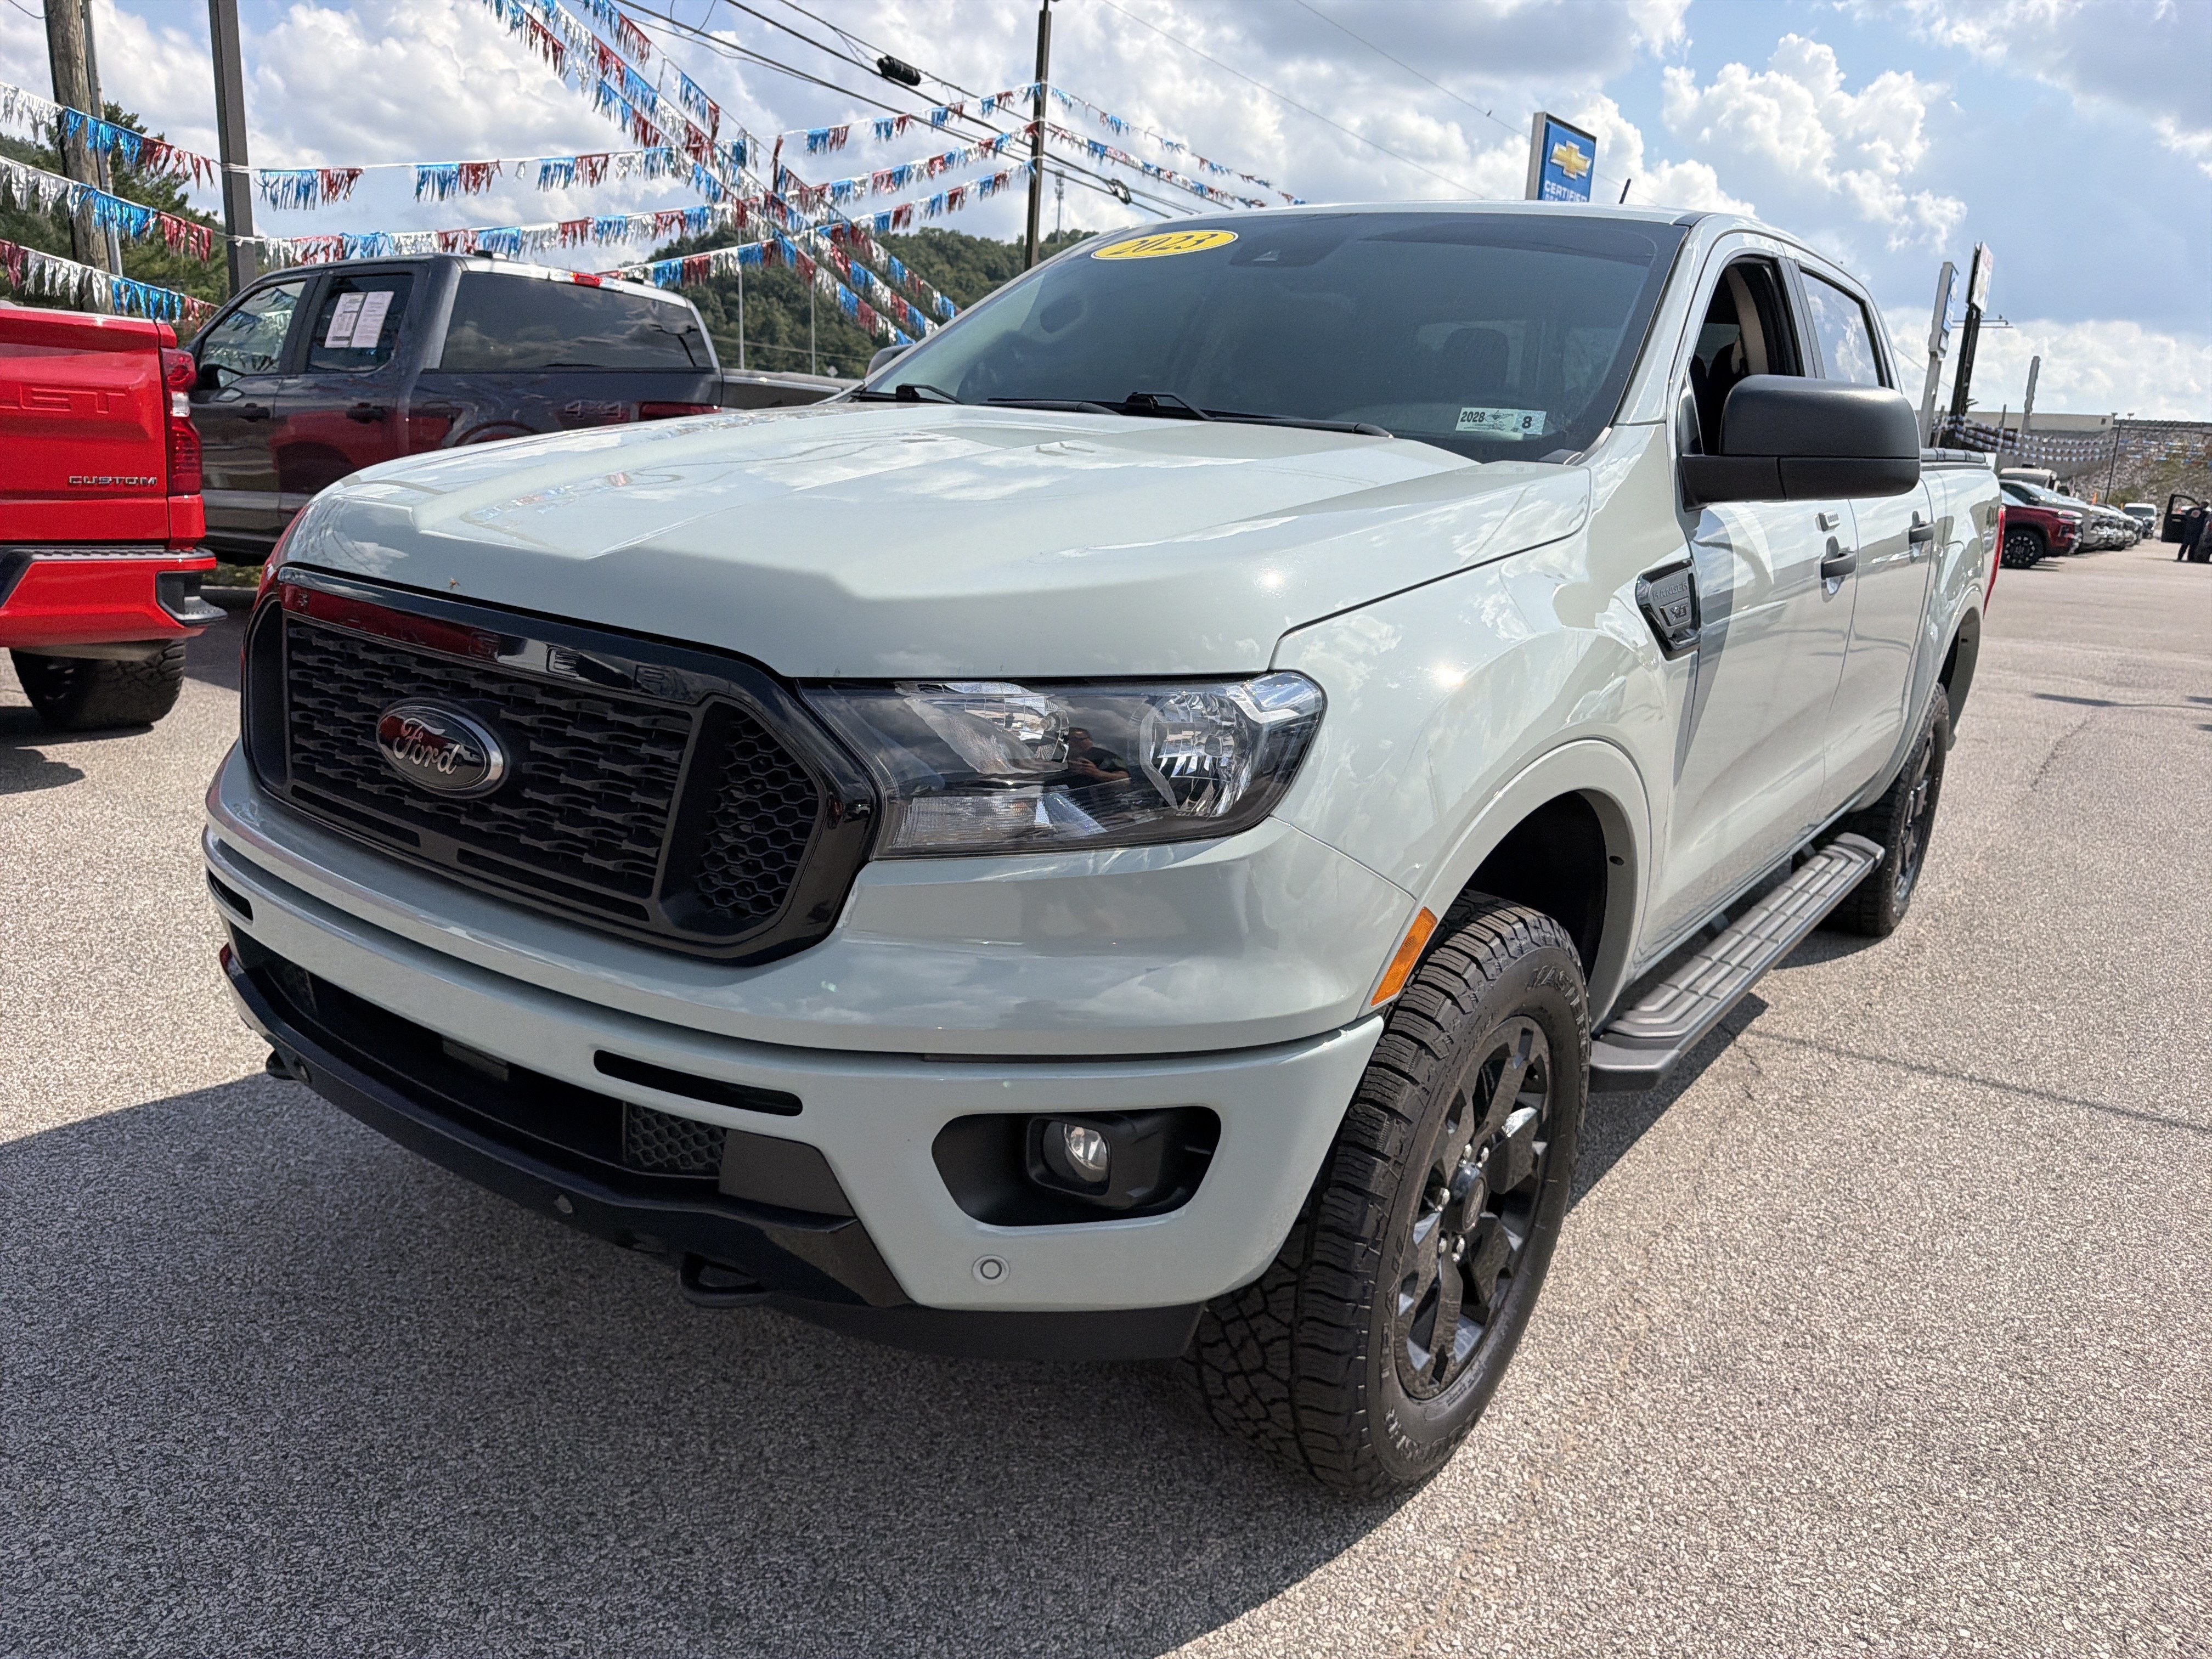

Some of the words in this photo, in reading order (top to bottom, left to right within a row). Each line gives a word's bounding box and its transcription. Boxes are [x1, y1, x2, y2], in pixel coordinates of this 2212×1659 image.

[1107, 233, 1219, 256] 2023
[1460, 411, 1486, 422] 2028
[1521, 416, 1532, 429] 8
[69, 475, 157, 486] CUSTOM
[1652, 582, 1688, 601] RANGER
[1669, 603, 1689, 622] XLT
[393, 717, 461, 775] Ford
